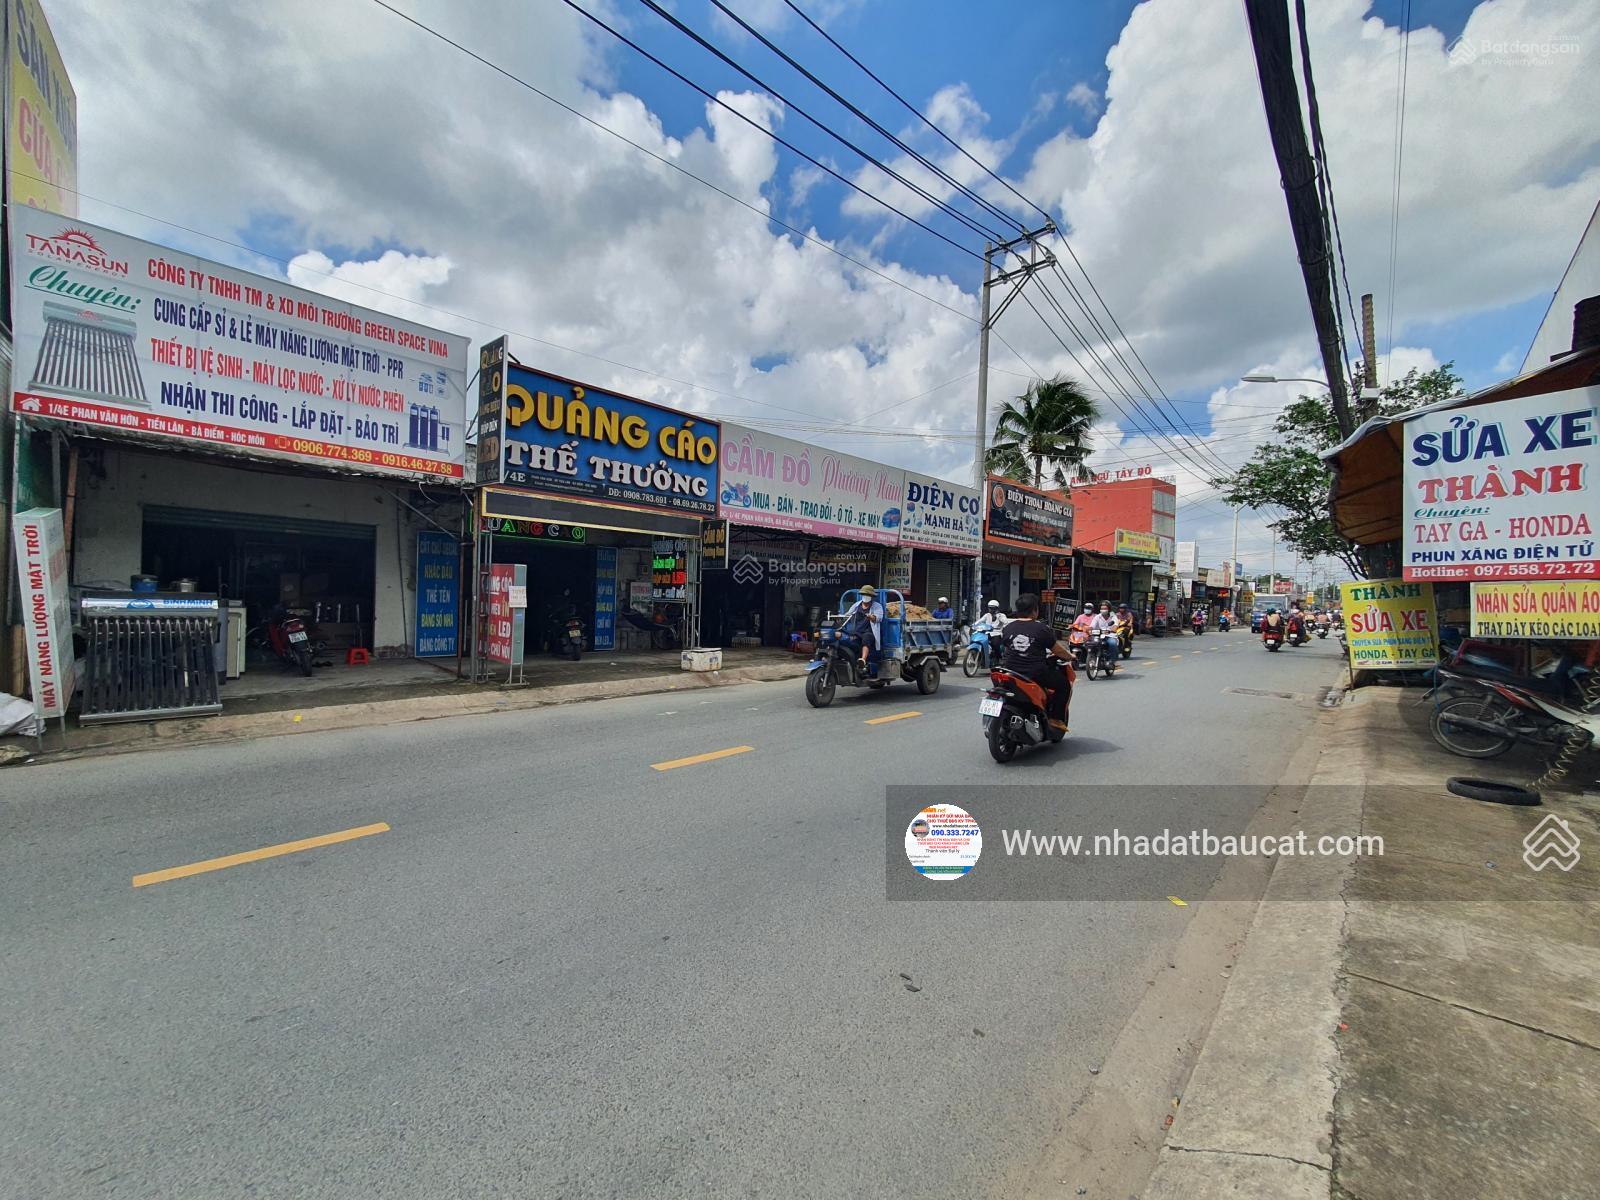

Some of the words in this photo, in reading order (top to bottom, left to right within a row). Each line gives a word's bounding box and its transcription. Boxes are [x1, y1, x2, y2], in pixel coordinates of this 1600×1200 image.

[26, 234, 128, 275] TANASUN
[148, 258, 185, 286] CÔNG
[189, 270, 205, 291] TY
[207, 275, 241, 302] TNHH
[244, 286, 262, 307] TM
[266, 293, 275, 311] &
[278, 296, 294, 316] XD
[297, 301, 318, 323] MÔI
[321, 309, 362, 335] TRƯỜNG
[364, 321, 395, 344] GREEN
[397, 330, 426, 352] SPACE
[428, 339, 449, 359] VINA
[153, 297, 186, 328] CUNG
[189, 301, 212, 333] CẤP
[214, 307, 226, 337] SỈ
[229, 317, 238, 340] &
[240, 314, 253, 344] LẺ
[255, 321, 278, 350] MÁY
[280, 327, 308, 357] NĂNG
[309, 339, 339, 366] LƯỢNG
[341, 344, 360, 373] MẶT
[362, 350, 380, 374] TRỜI
[387, 358, 404, 380] PPR
[151, 336, 183, 367] THIẾT
[185, 346, 197, 375] BỊ
[200, 346, 214, 378] VỆ
[217, 353, 243, 379] SINH
[253, 359, 276, 386] MÁY
[278, 366, 296, 394] LỌC
[299, 371, 324, 397] NƯỚC
[332, 374, 346, 401] XỬ
[346, 379, 357, 402] LÝ
[358, 384, 381, 408] NƯỚC
[383, 389, 405, 413] PHÈN
[161, 381, 207, 415] NHẬN
[211, 391, 235, 417] THI
[239, 394, 278, 424] CÔNG
[292, 400, 317, 431] LẮP
[320, 410, 344, 439] ĐẶT
[355, 414, 379, 442] BẢO
[382, 420, 400, 445] TRÌ
[506, 383, 650, 449] QUẢNG
[659, 420, 717, 465] CÁO
[48, 403, 69, 417] 1/4E
[71, 406, 98, 421] PHAN
[99, 410, 119, 424] VĂN
[293, 439, 372, 463] 0906.774.369
[1411, 414, 1508, 467] SỬA
[1523, 407, 1598, 454] XE
[505, 440, 579, 476] THẾ
[589, 455, 709, 497] THƯỞNG
[722, 431, 776, 480] CẦM
[782, 446, 812, 487] ĐỒ
[1115, 467, 1134, 479] TÂY
[1137, 463, 1153, 476] ĐÔ
[907, 481, 955, 512] ĐIỆN
[958, 495, 981, 516] CƠ
[1418, 463, 1585, 504] THÀNH
[753, 491, 770, 510] MUA
[777, 493, 794, 514] BÁN
[800, 500, 819, 518] TRAO
[820, 497, 833, 520] ĐỔI
[837, 504, 843, 522] Ô
[844, 505, 853, 524] TÔ
[858, 511, 866, 526] XE
[868, 510, 881, 529] MÁY
[1024, 495, 1043, 511] THOẠI
[1413, 505, 1491, 519] Chuyên:
[924, 513, 951, 530] MẠNH
[1414, 522, 1453, 544] TAY
[1459, 520, 1488, 541] GA
[1508, 513, 1592, 539] HONDA
[22, 524, 40, 558] TRỜI
[1411, 550, 1455, 563] PHUN
[1461, 546, 1508, 561] XĂNG
[1513, 543, 1559, 561] ĐIỆN
[1565, 539, 1595, 558] TỬ
[29, 560, 46, 591] MẶT
[1411, 566, 1469, 578] Hotline:
[1474, 562, 1596, 577] 097.558.72.72
[1350, 583, 1422, 601] THÀNH
[1476, 587, 1509, 618] NHẬN
[1512, 583, 1538, 613] SỬA
[1541, 582, 1577, 617] QUẦN
[1581, 585, 1600, 613] ÁO
[31, 594, 50, 638] LƯỢNG
[498, 620, 511, 638] LED
[1350, 605, 1394, 633] SỬA
[1400, 609, 1430, 632] XE
[1477, 621, 1504, 636] THAY
[1529, 618, 1550, 636] KÉO
[1552, 618, 1574, 636] CÁC
[36, 640, 52, 677] NĂNG
[1354, 649, 1389, 660] HONDA
[1398, 647, 1418, 659] TAY
[1422, 648, 1436, 658] GA
[38, 680, 57, 709] MÁY
